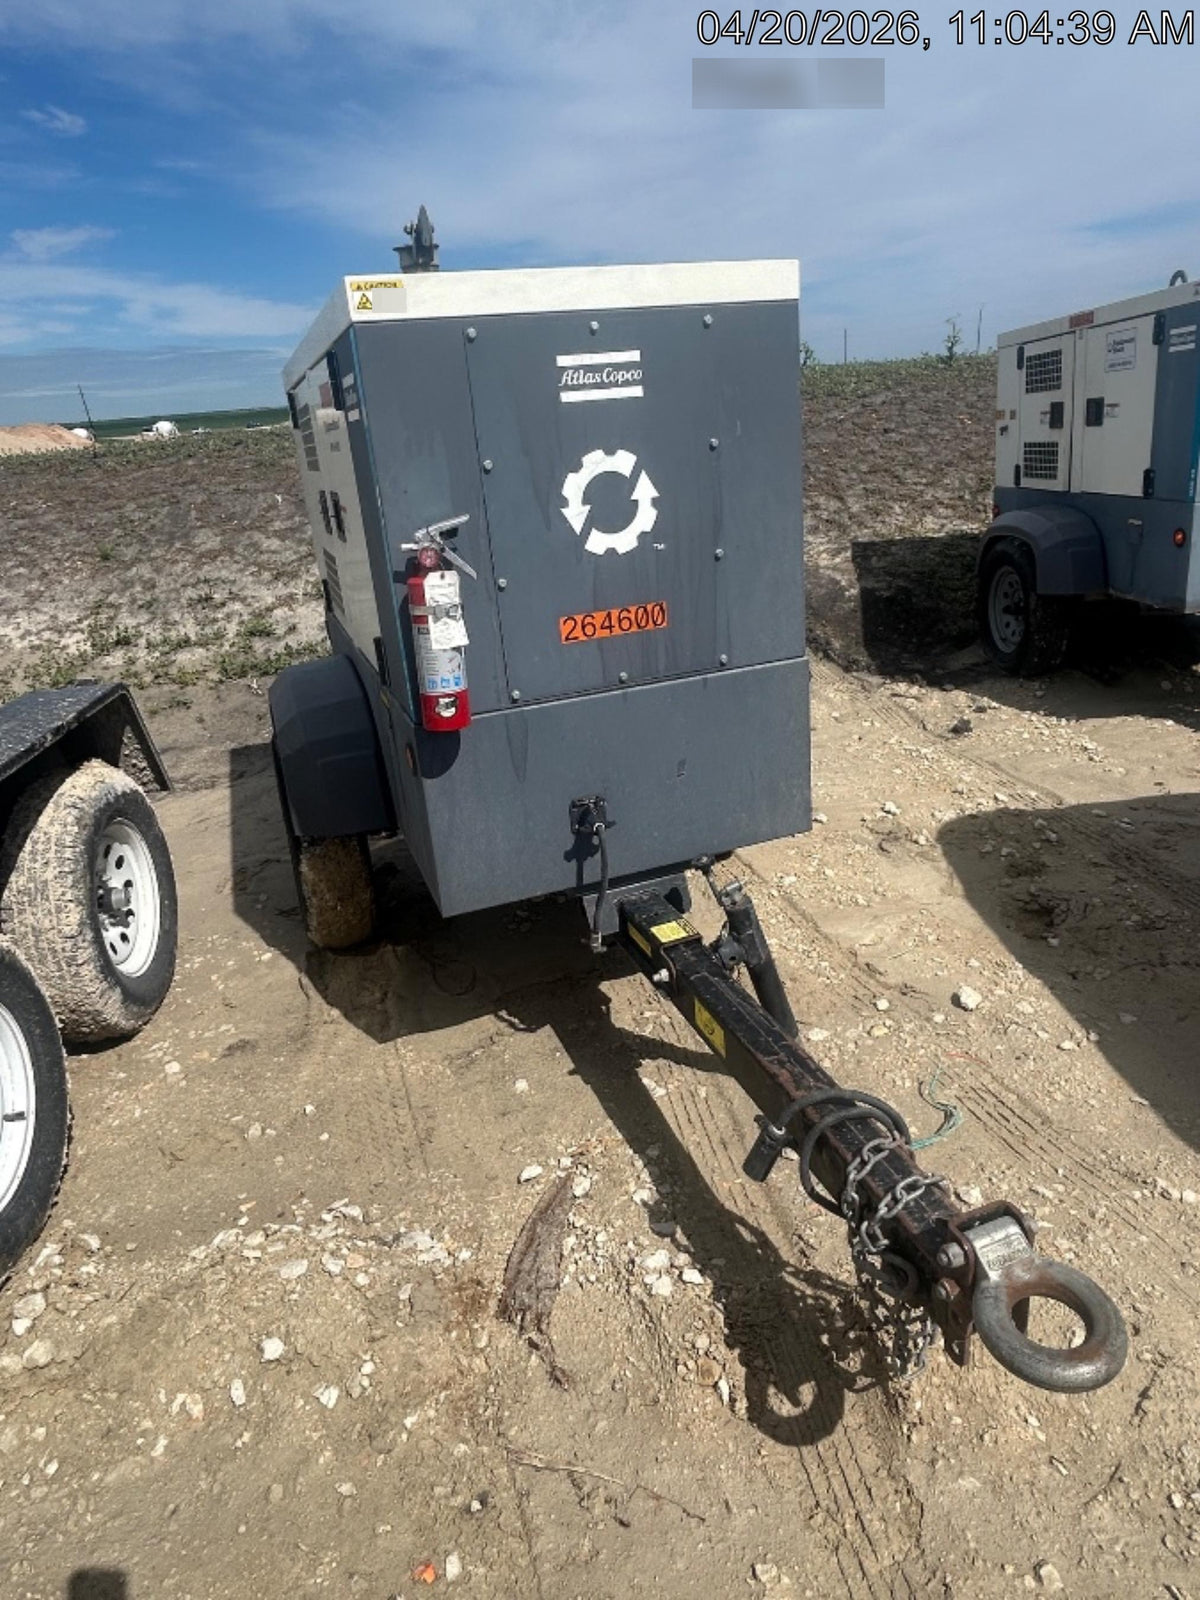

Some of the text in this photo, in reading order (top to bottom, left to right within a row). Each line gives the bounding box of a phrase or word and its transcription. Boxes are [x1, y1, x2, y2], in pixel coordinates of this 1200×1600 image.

[558, 366, 643, 387] Atlas Copco
[562, 602, 666, 642] 264600
